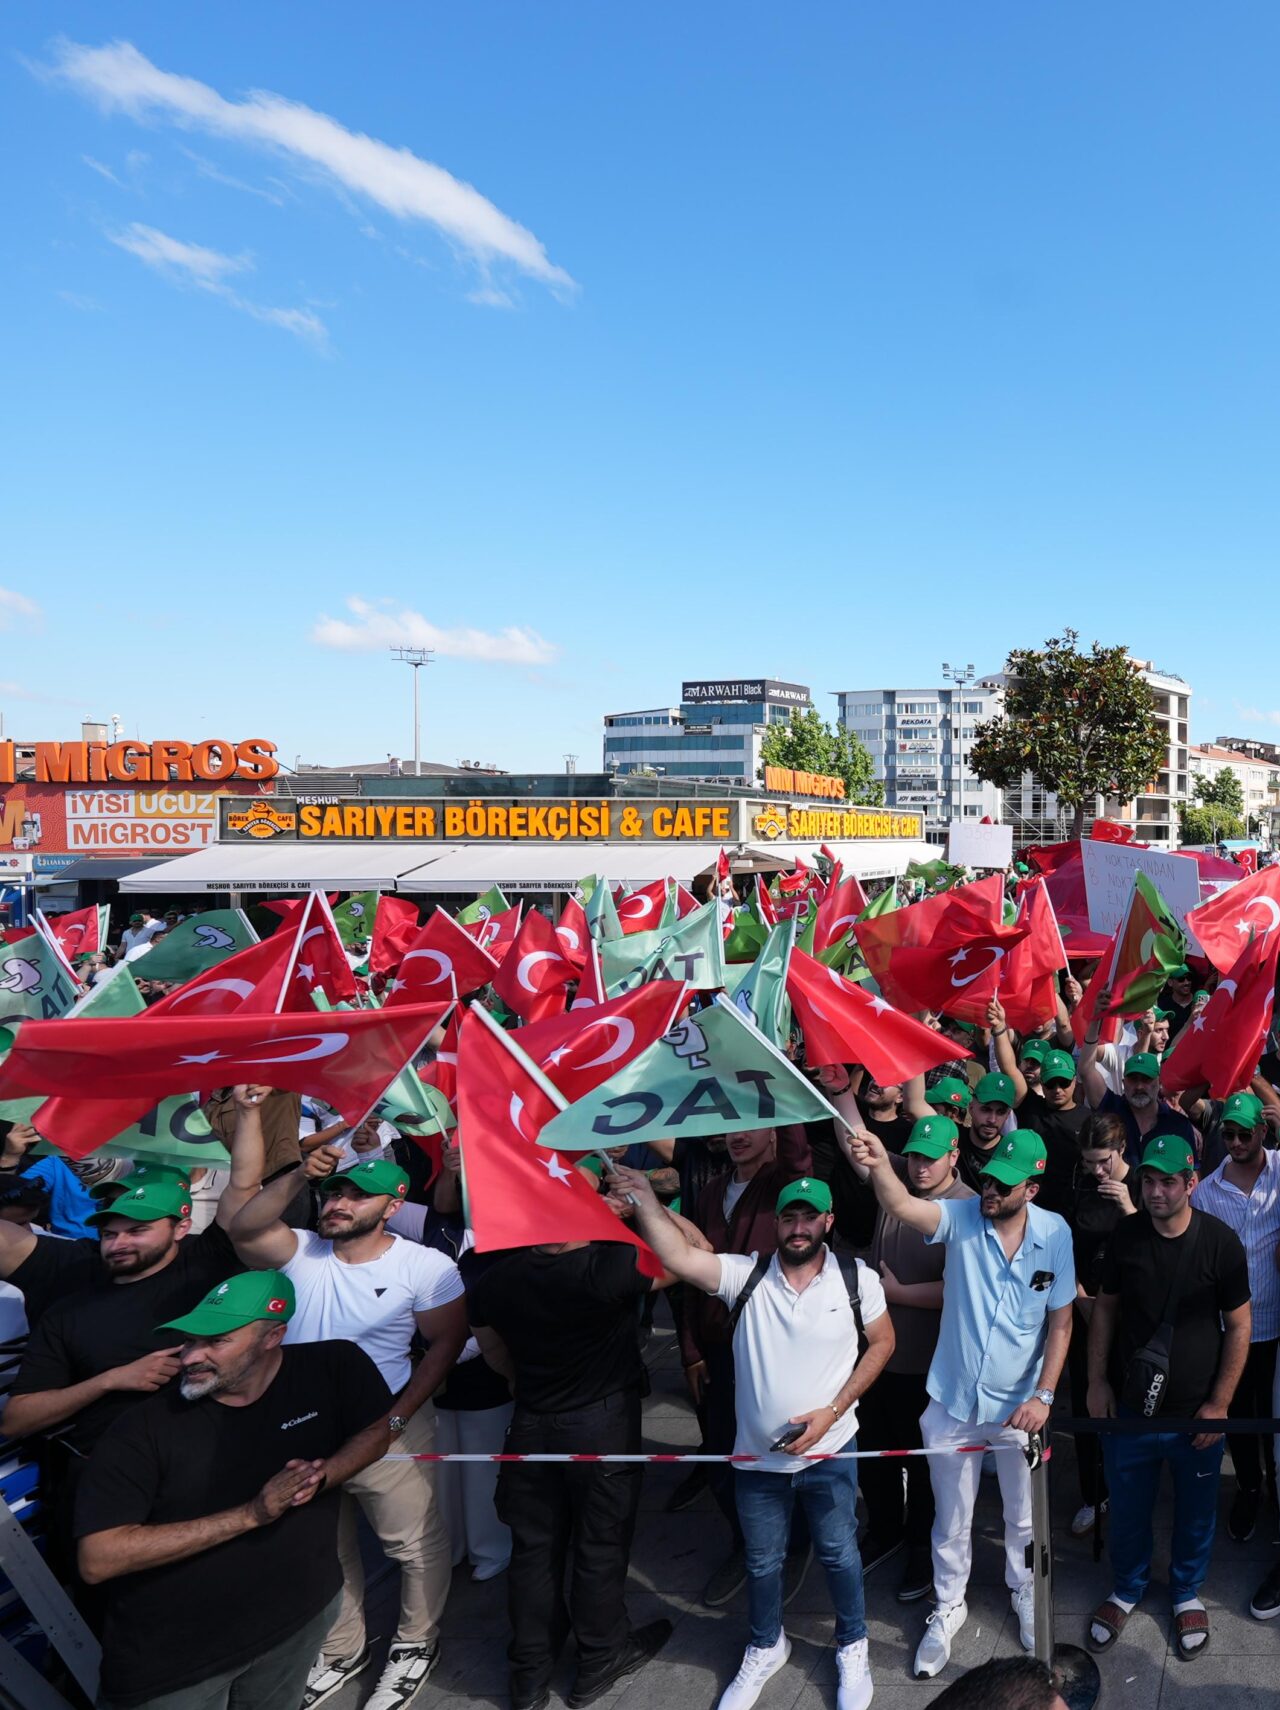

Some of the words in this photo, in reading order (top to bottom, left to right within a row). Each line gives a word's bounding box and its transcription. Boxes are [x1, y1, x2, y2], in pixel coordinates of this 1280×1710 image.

[691, 684, 741, 697] MARWAH
[743, 684, 762, 695] Black
[772, 689, 808, 701] MARWAH
[296, 796, 339, 805] MEŞHUR
[300, 806, 436, 837] SARIYER
[446, 801, 610, 841] BÖREKÇİSİ
[619, 806, 642, 837] &
[652, 807, 730, 837] CAFE
[790, 809, 841, 837] SARIYER
[893, 818, 900, 836] &
[901, 815, 920, 837] CAFE
[1143, 1373, 1165, 1417] adidas
[288, 1411, 318, 1428] Columbia
